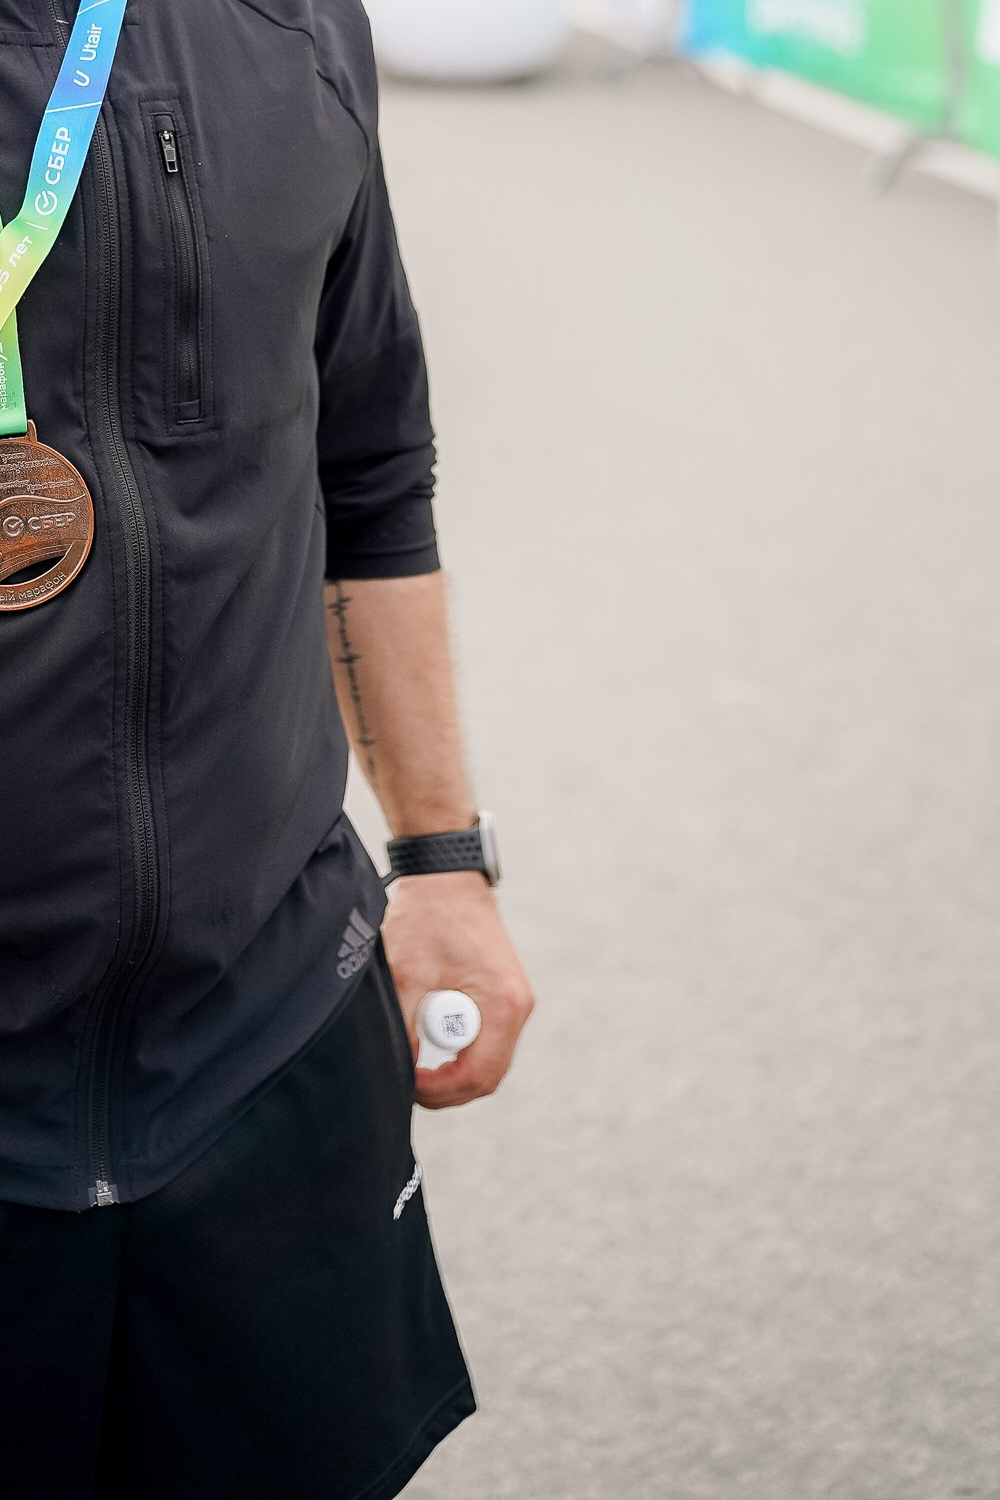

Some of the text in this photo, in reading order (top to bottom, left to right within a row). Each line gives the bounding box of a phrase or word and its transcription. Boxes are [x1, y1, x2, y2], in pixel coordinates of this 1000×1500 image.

[79, 23, 104, 62] Utair
[44, 126, 72, 186] СБЕР
[8, 234, 34, 268] лет
[27, 511, 76, 531] СБЕР
[18, 571, 67, 601] марафон
